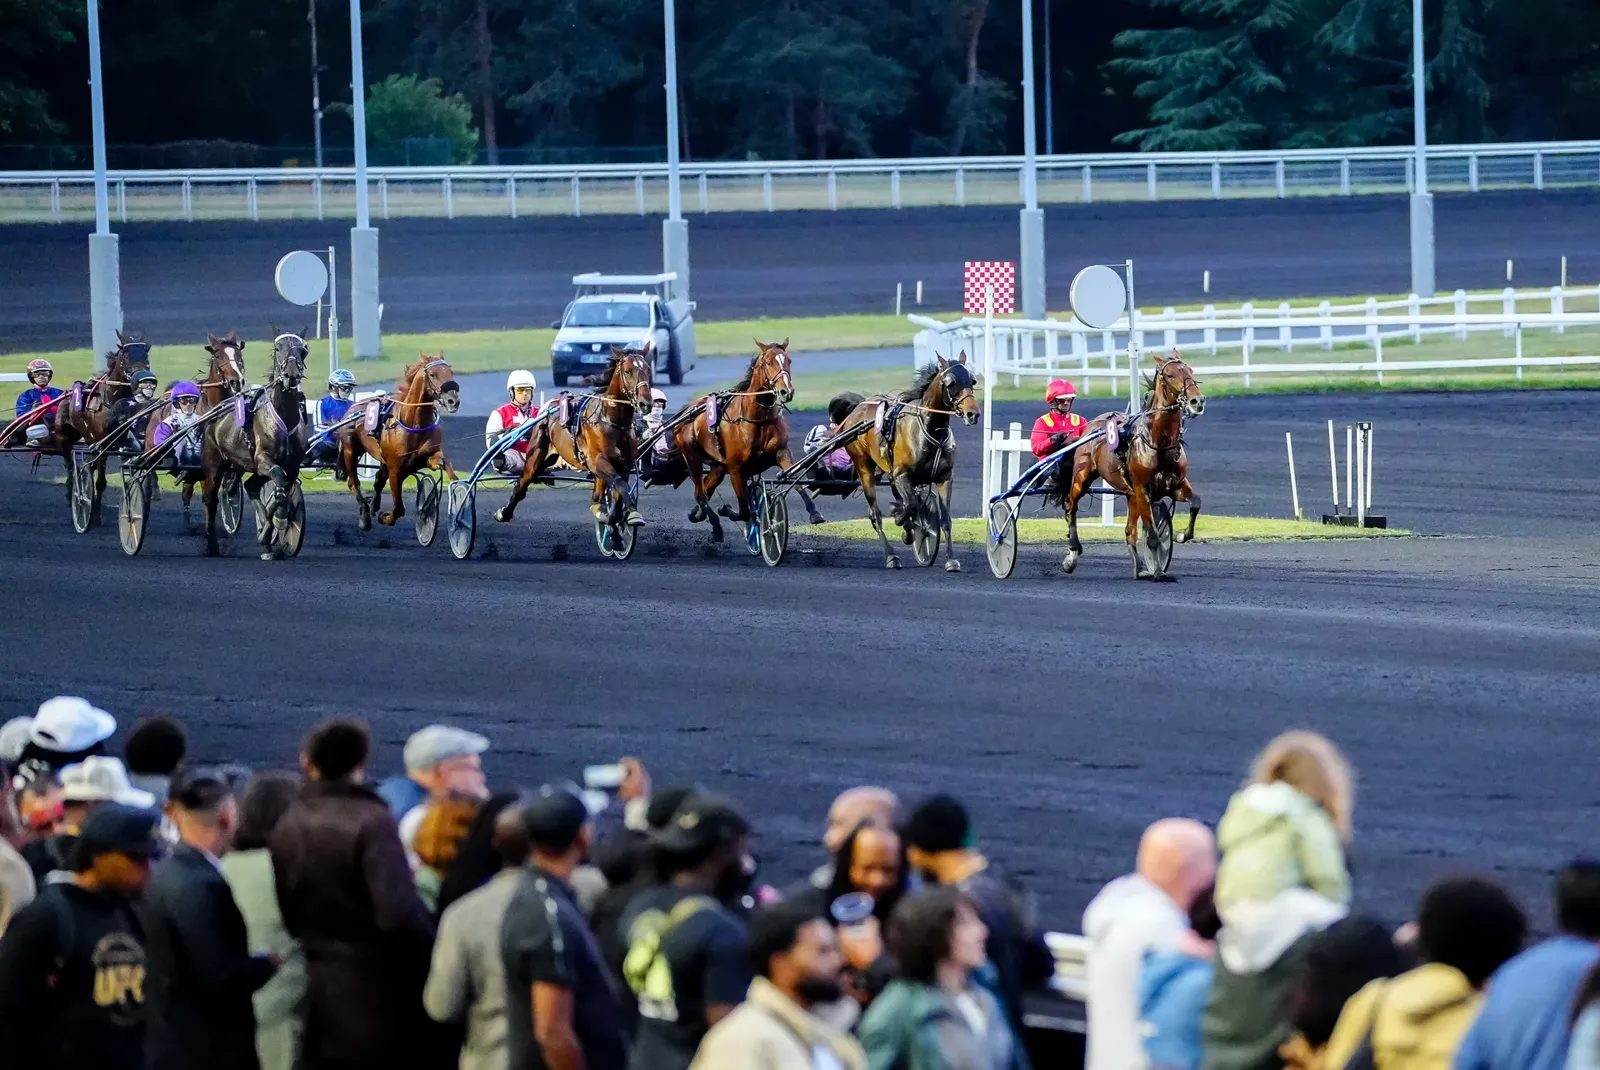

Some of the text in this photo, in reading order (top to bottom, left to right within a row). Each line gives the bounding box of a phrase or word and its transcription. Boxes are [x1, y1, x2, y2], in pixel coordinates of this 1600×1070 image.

[74, 389, 80, 407] 2
[237, 399, 242, 420] 1
[367, 405, 376, 426] 5
[708, 400, 714, 420] 3
[1107, 421, 1117, 445] 8
